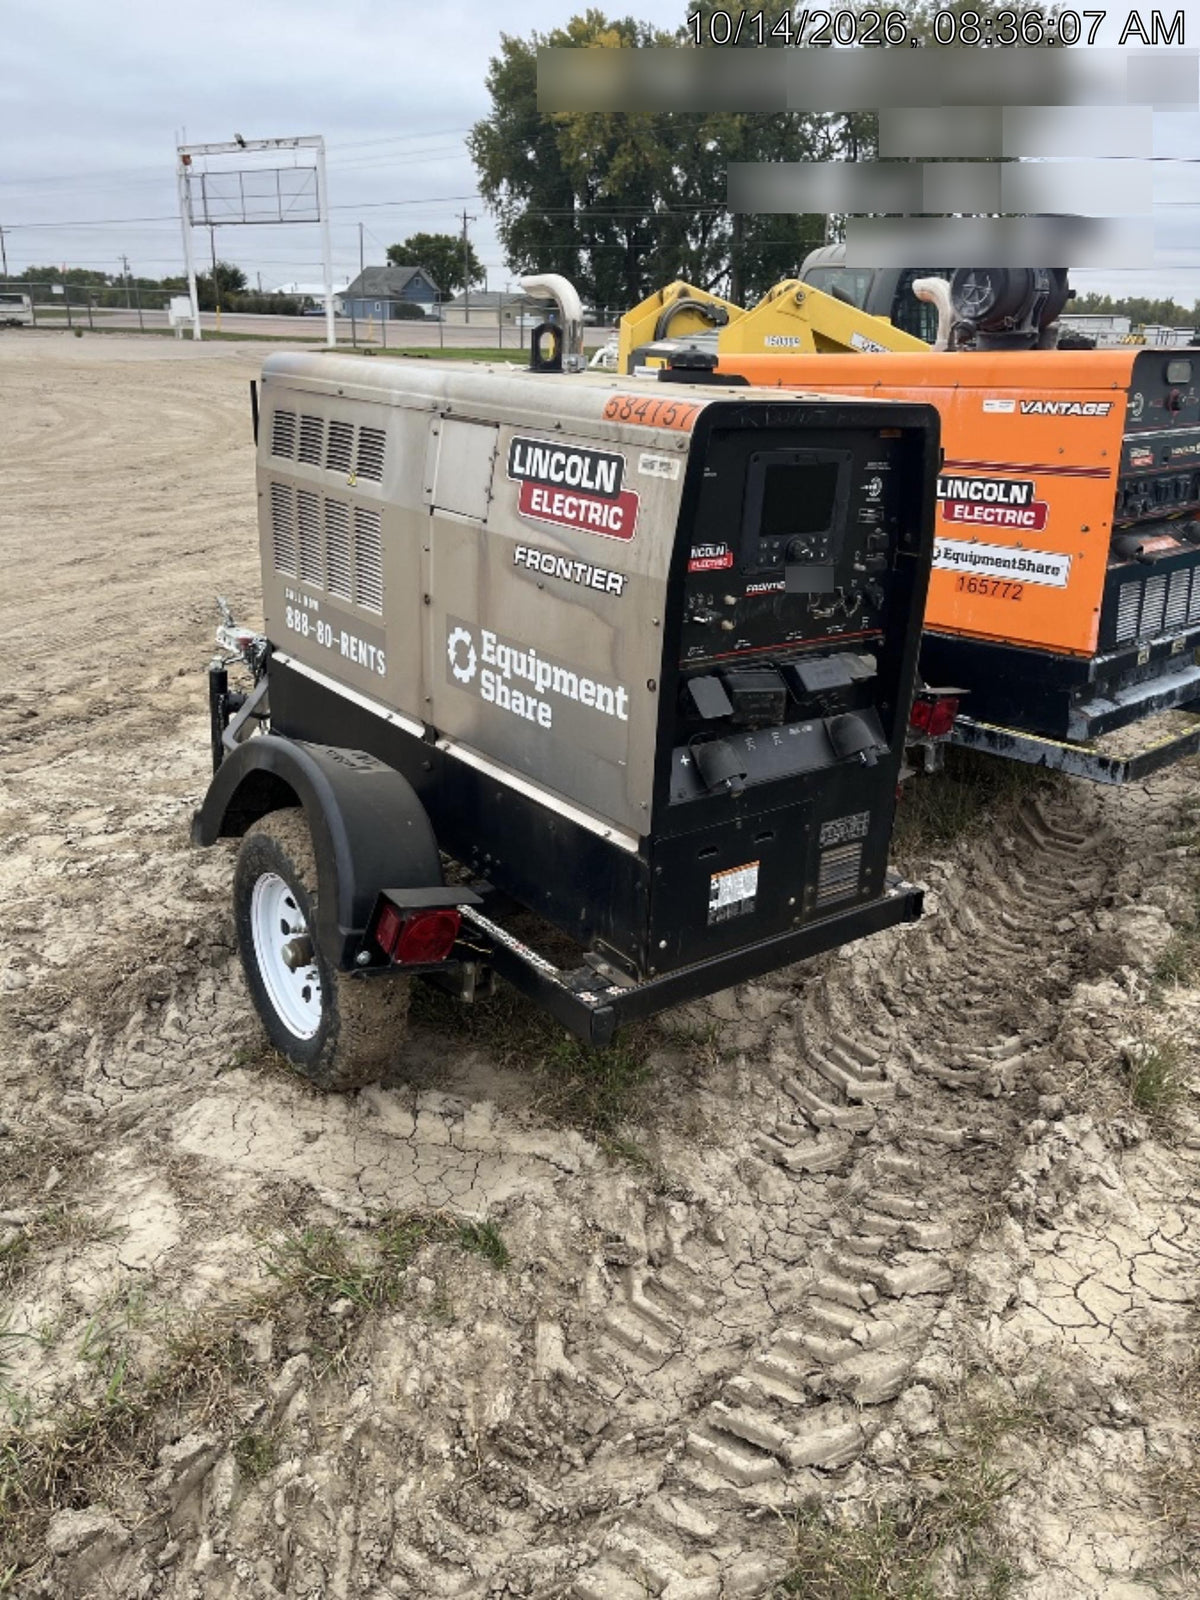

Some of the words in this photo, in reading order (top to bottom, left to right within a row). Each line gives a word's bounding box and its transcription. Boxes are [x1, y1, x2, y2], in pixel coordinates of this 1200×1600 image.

[605, 396, 699, 428] 584157
[1019, 400, 1112, 416] VANTAGE
[513, 444, 618, 493] LINCOLN
[530, 488, 624, 531] ELECTRIC
[937, 478, 1028, 504] LINCOLN
[953, 503, 1036, 525] ELECTRIC
[514, 545, 625, 596] FRONTIER
[943, 546, 1061, 577] EquipmentShare
[957, 575, 1024, 601] 165772
[285, 605, 386, 677] 888-80-RENTS
[480, 628, 629, 721] Equipment
[480, 669, 552, 729] Share
